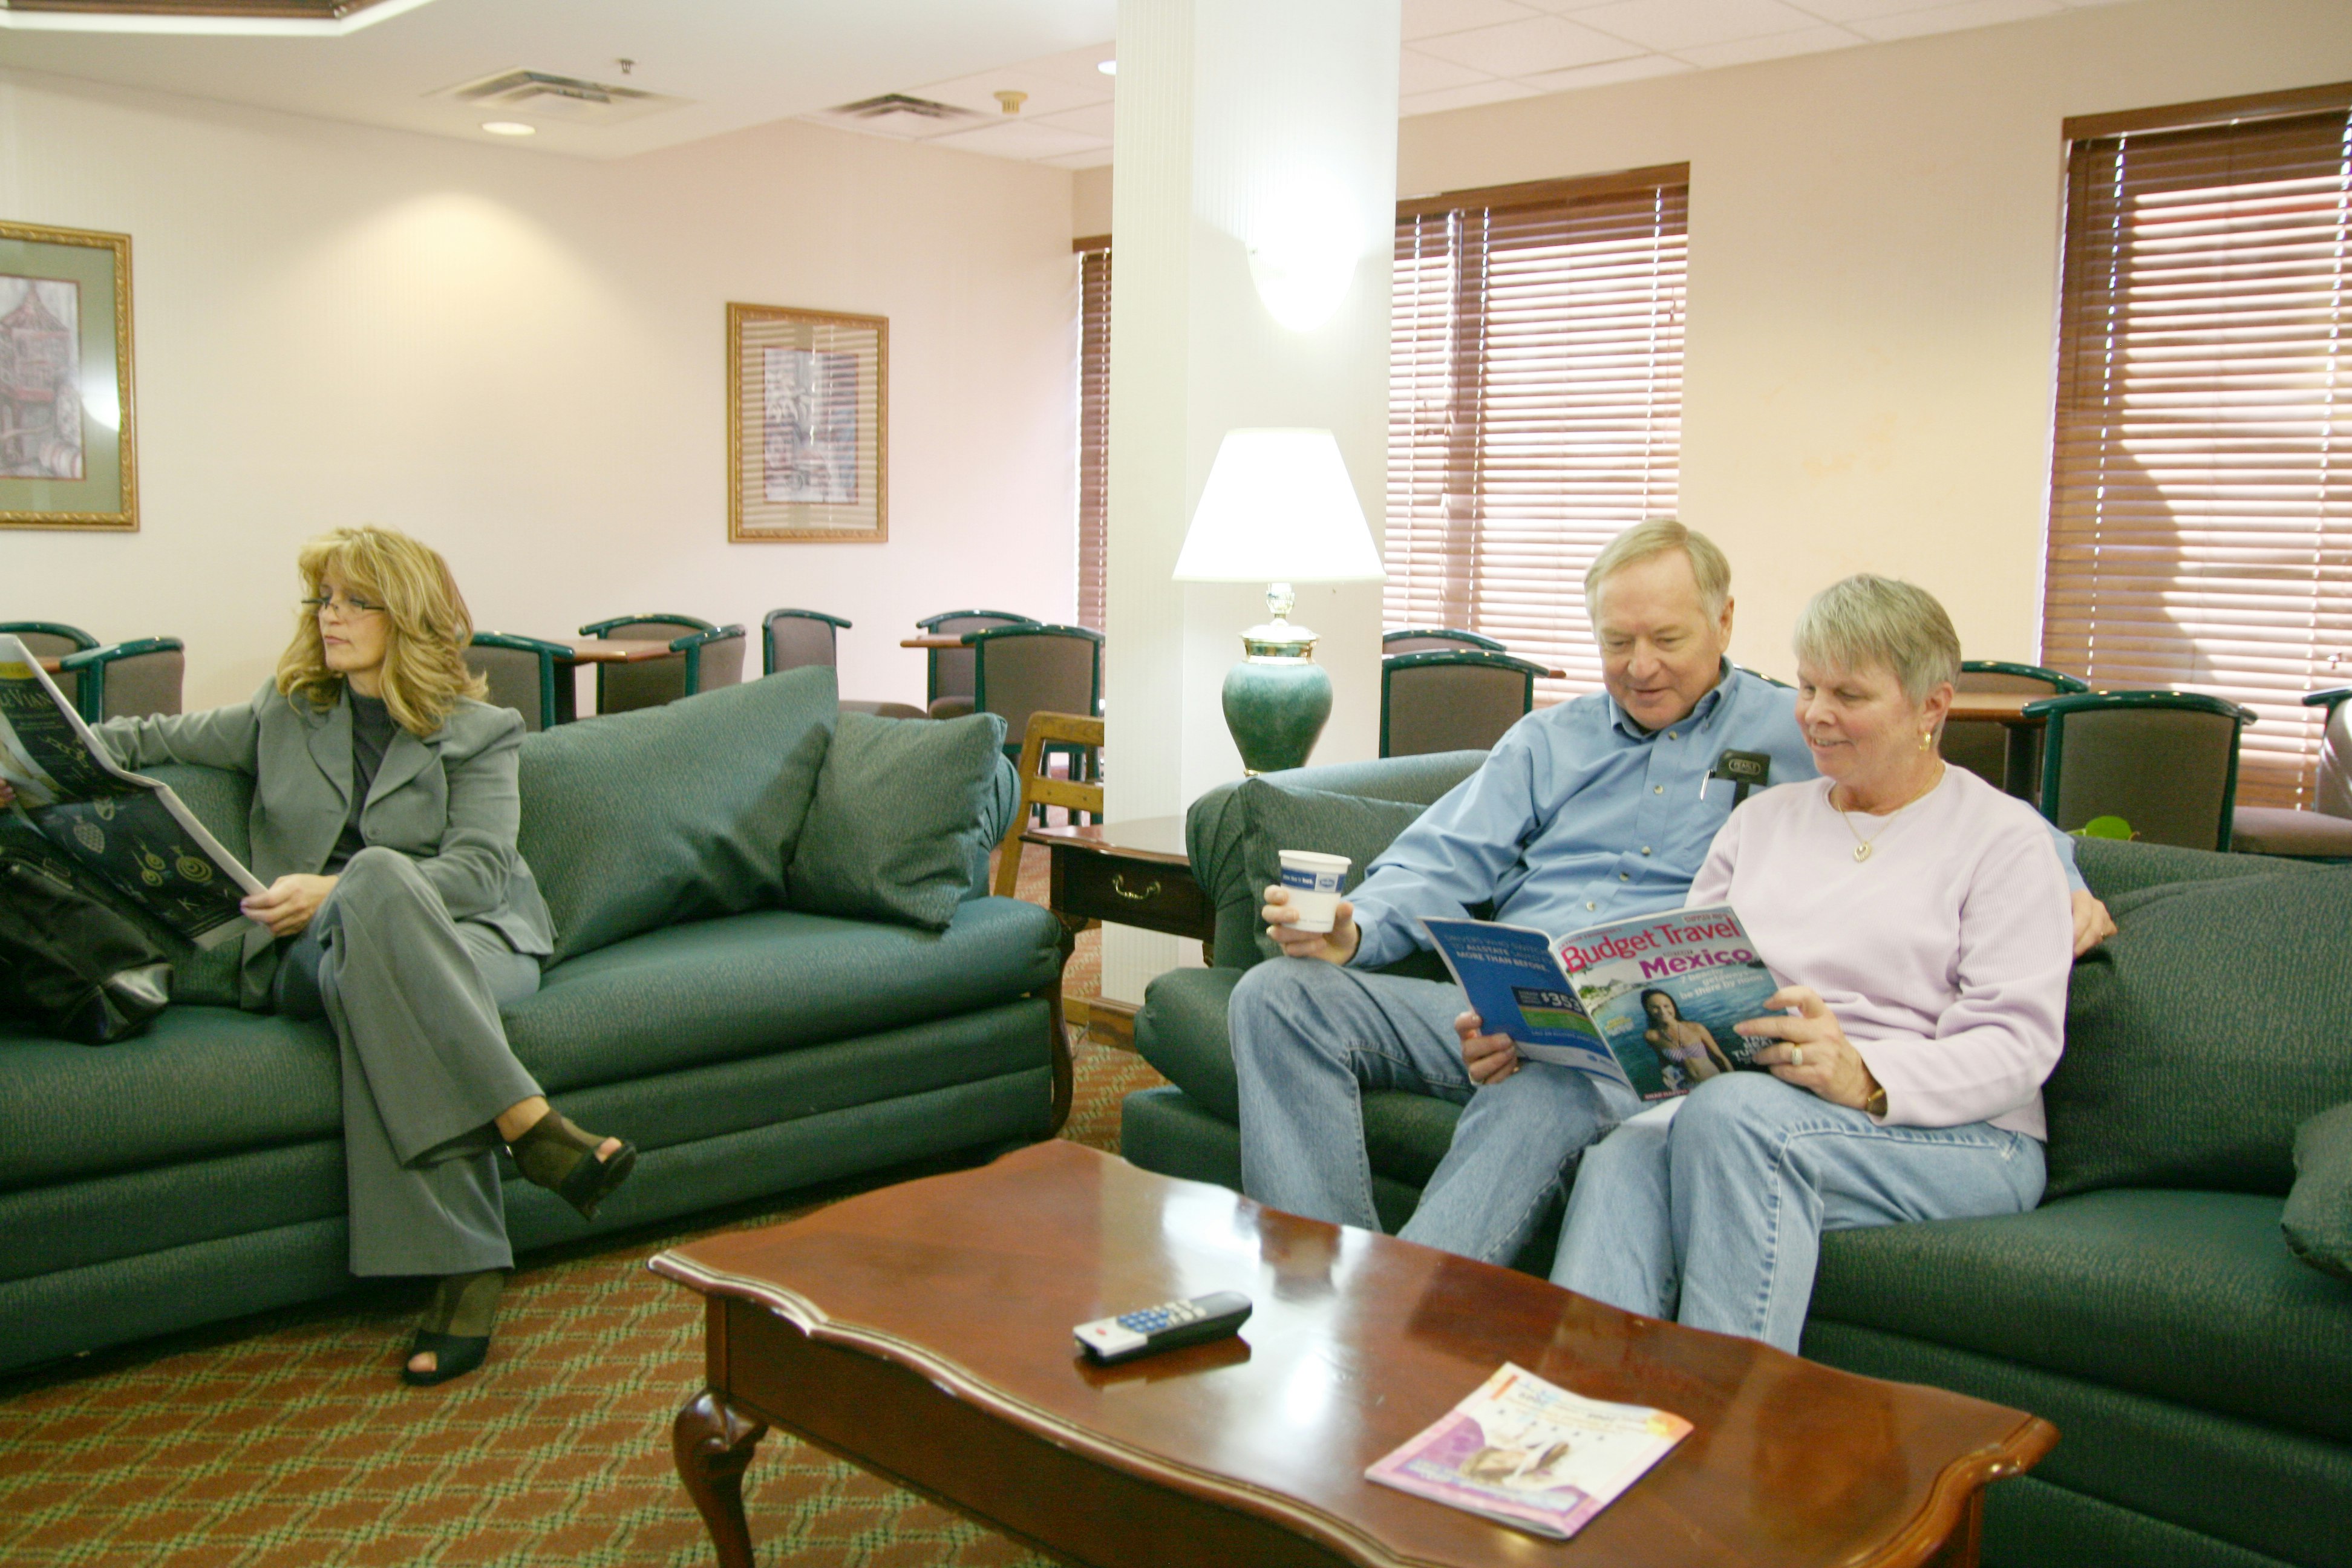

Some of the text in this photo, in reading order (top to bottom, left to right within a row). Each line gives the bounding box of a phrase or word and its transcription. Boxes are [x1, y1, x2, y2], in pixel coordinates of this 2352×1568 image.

[1561, 929, 1661, 973] Budget
[1653, 915, 1742, 945] Travel
[1638, 948, 1753, 979] Mexico
